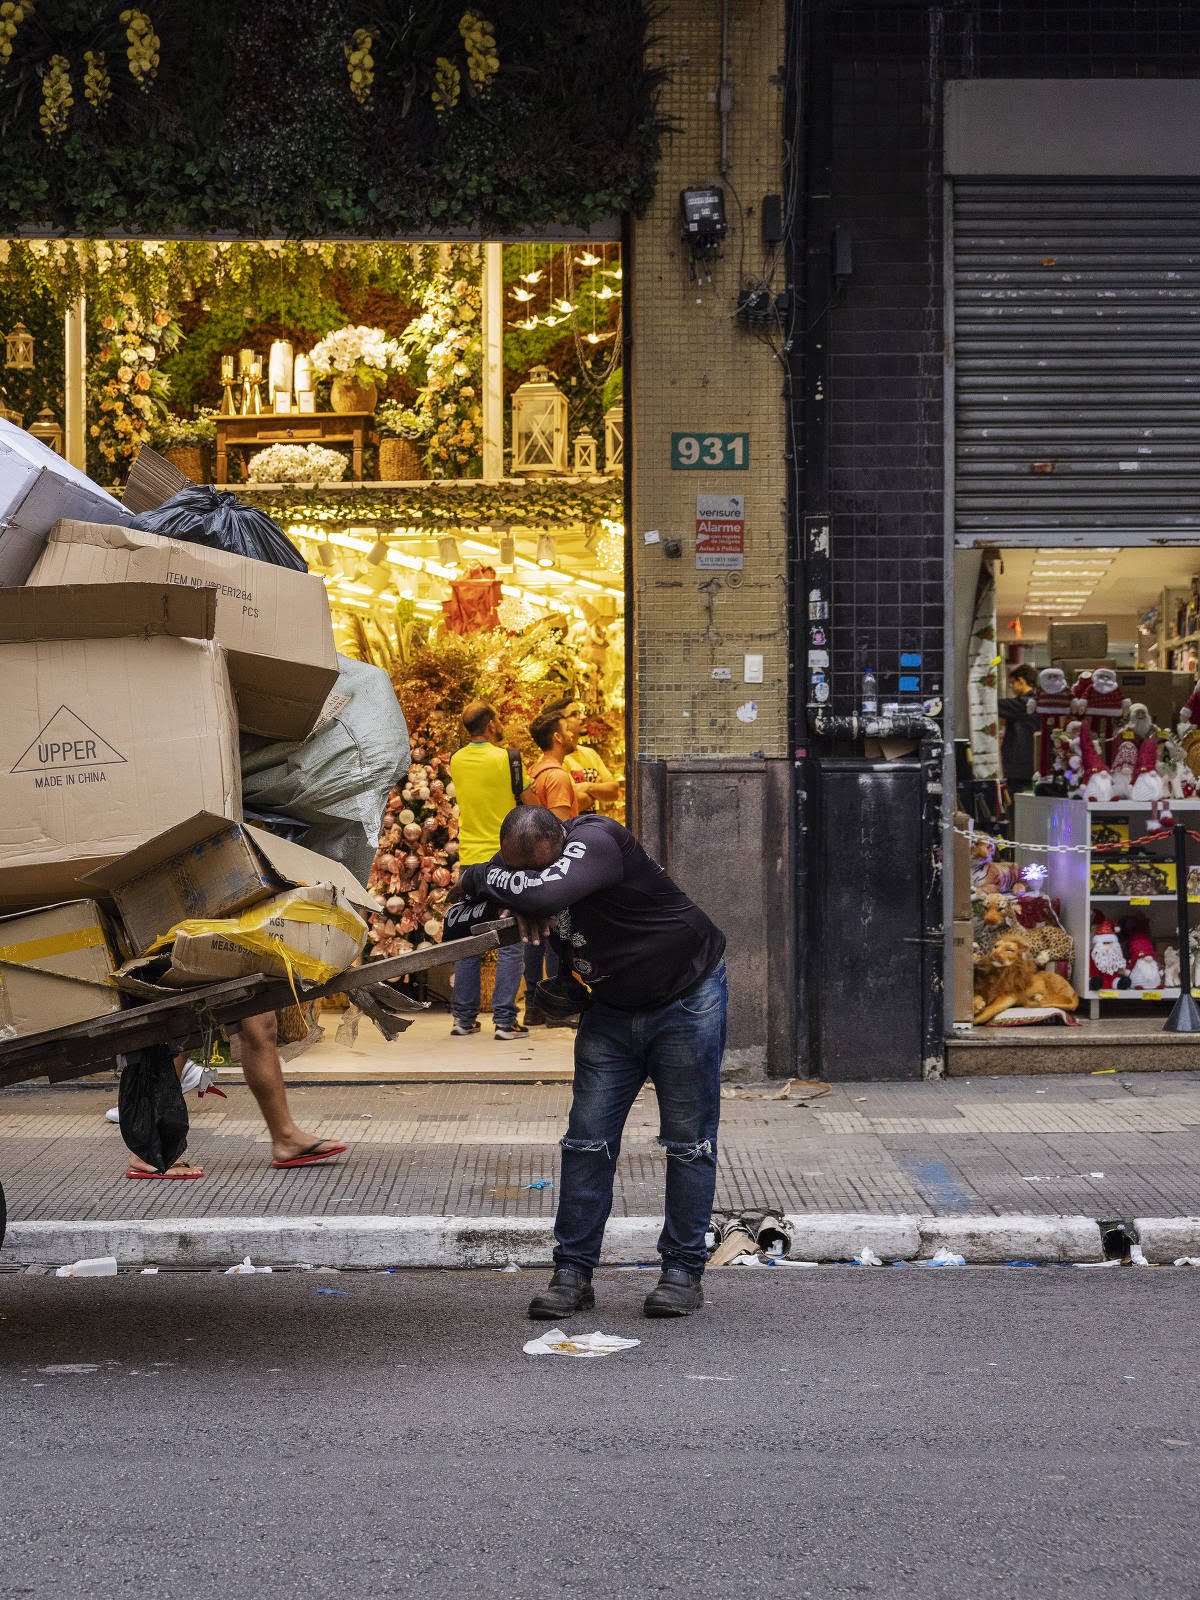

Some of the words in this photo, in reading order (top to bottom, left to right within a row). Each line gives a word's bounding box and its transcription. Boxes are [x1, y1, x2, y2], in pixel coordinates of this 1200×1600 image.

[678, 437, 743, 465] 931
[699, 509, 741, 518] verisure
[699, 521, 741, 532] Alarme
[166, 571, 188, 584] ITEM
[241, 606, 259, 618] PCS
[38, 740, 96, 763] UPPER
[35, 776, 62, 788] MADE
[66, 774, 75, 785] IN
[78, 771, 106, 783] CHINA
[269, 917, 285, 927] KGS
